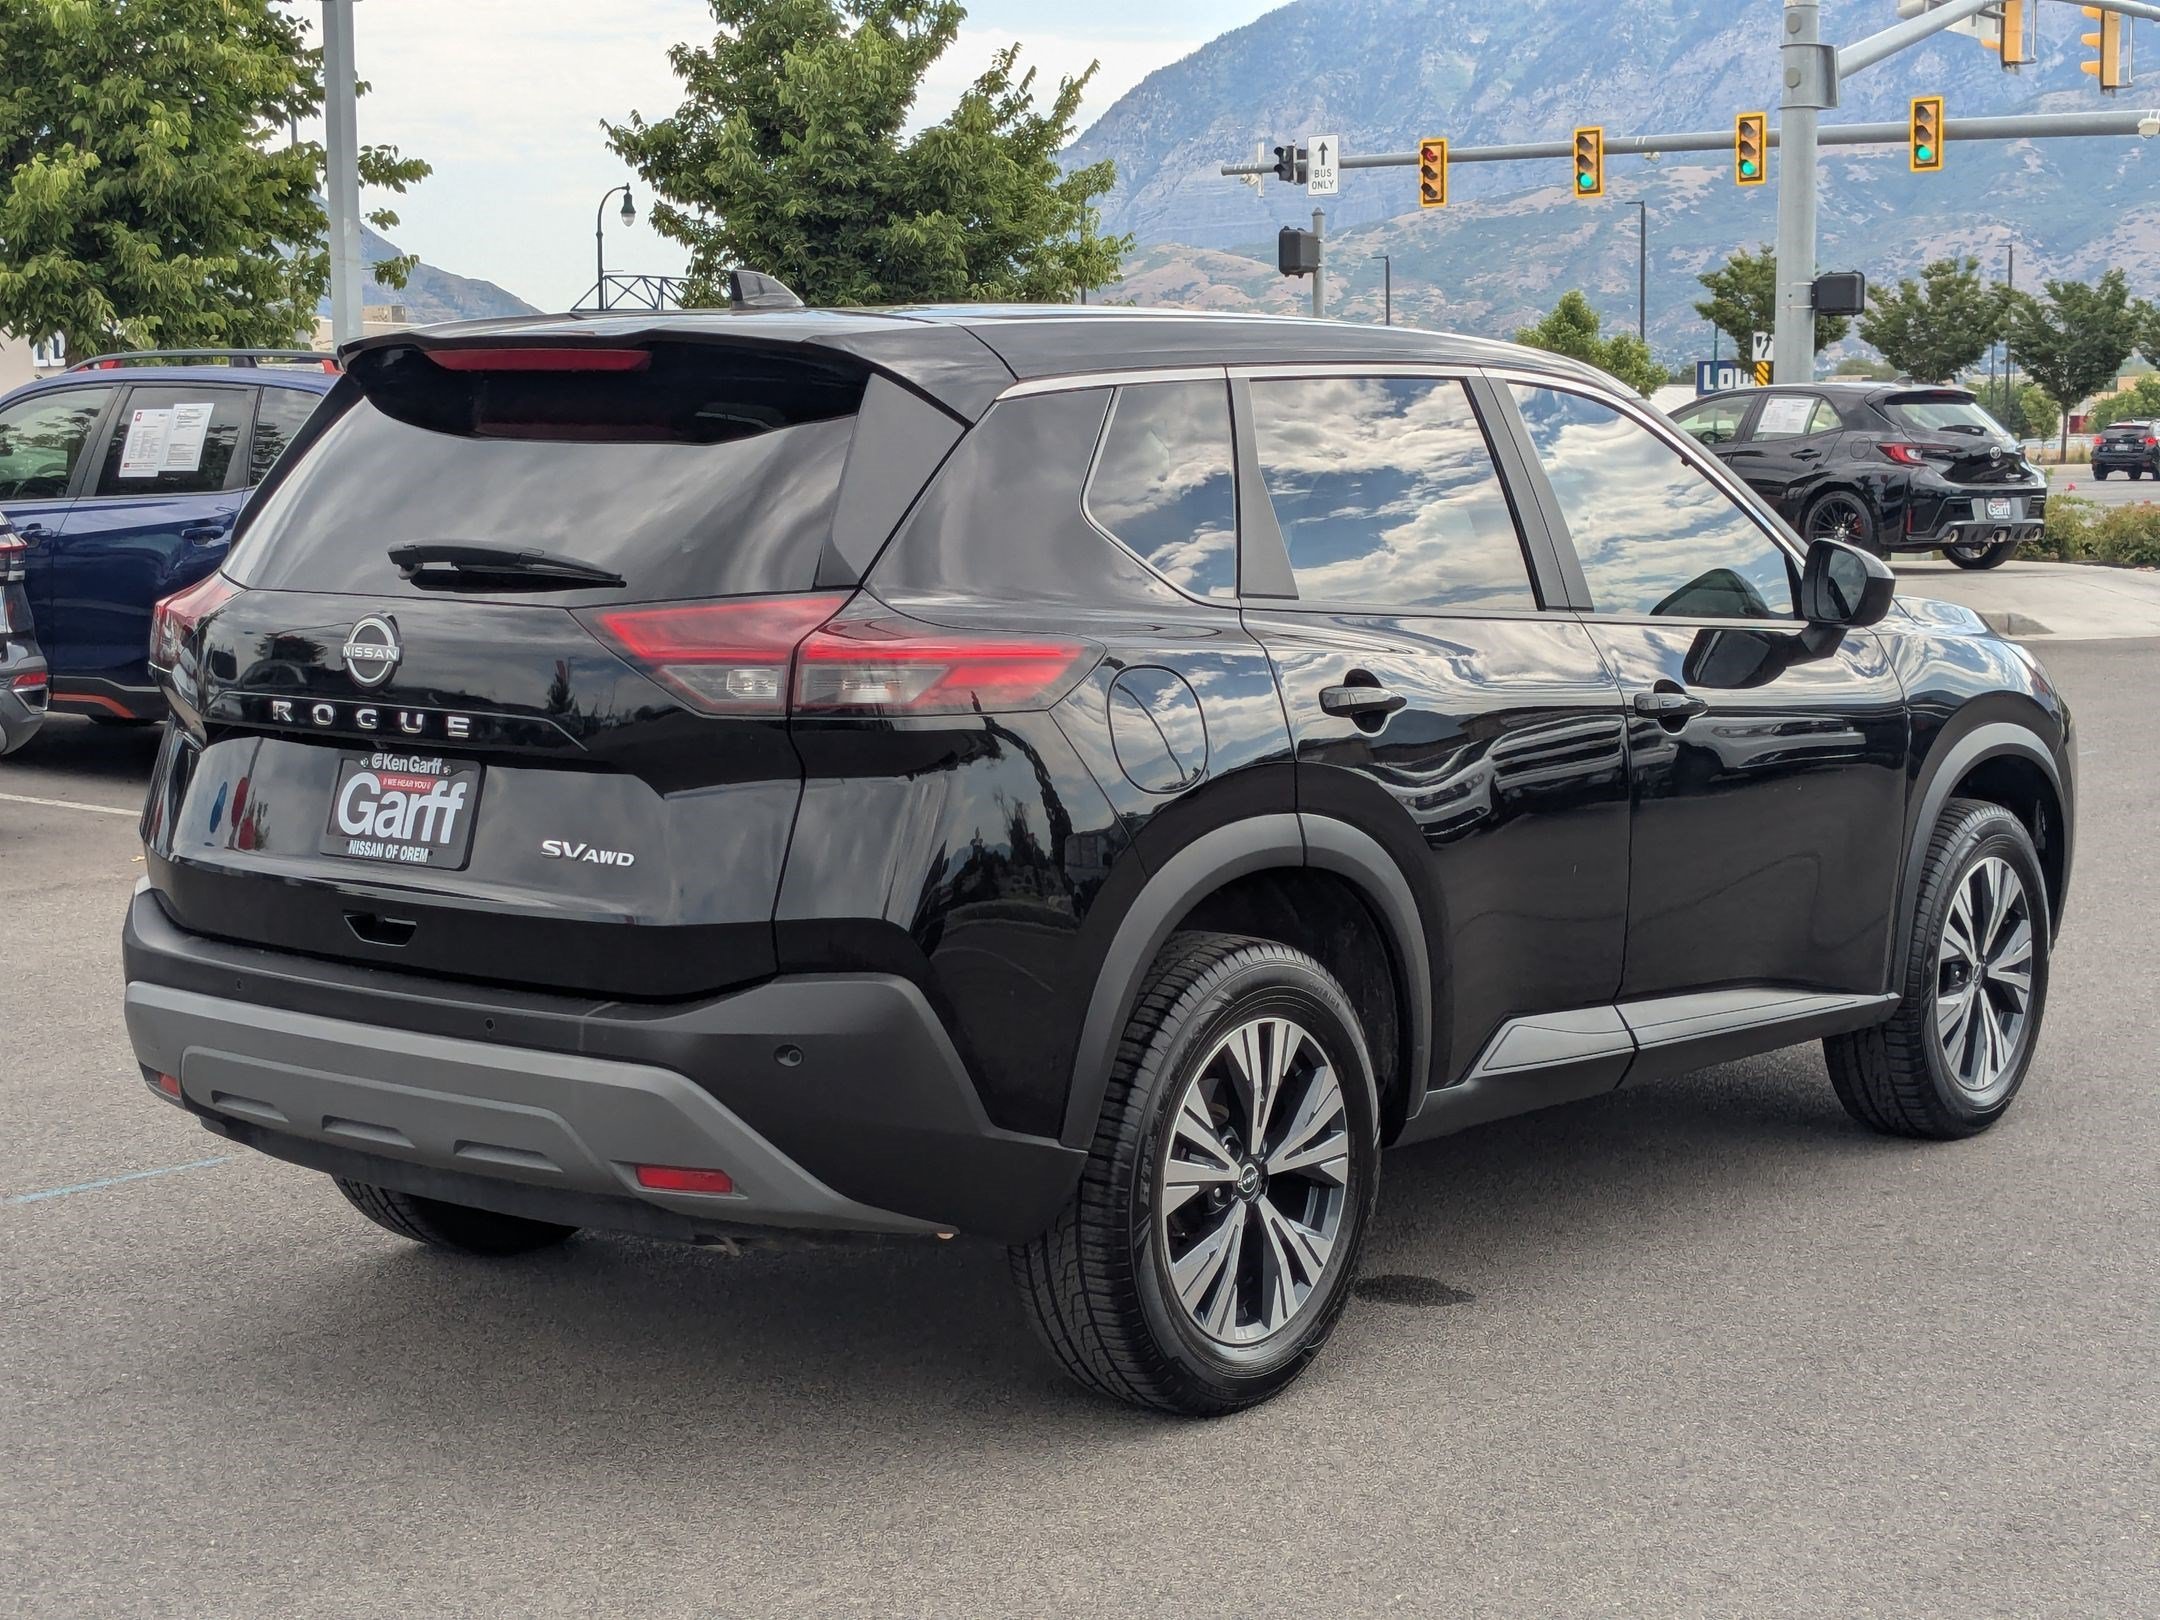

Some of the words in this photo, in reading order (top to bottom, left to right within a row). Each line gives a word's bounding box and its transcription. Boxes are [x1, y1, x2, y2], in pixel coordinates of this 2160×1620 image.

[1314, 169, 1332, 178] BUS
[1311, 180, 1335, 190] ONLY
[343, 645, 397, 661] NISSAN
[272, 700, 470, 738] ROGUE
[382, 753, 407, 772] Ken
[408, 756, 442, 775] Garff
[387, 778, 397, 786] WE
[414, 780, 427, 789] YOU
[338, 772, 467, 844] Garff
[348, 839, 384, 858] NISSAN
[385, 845, 400, 861] OF
[400, 847, 430, 863] OREM
